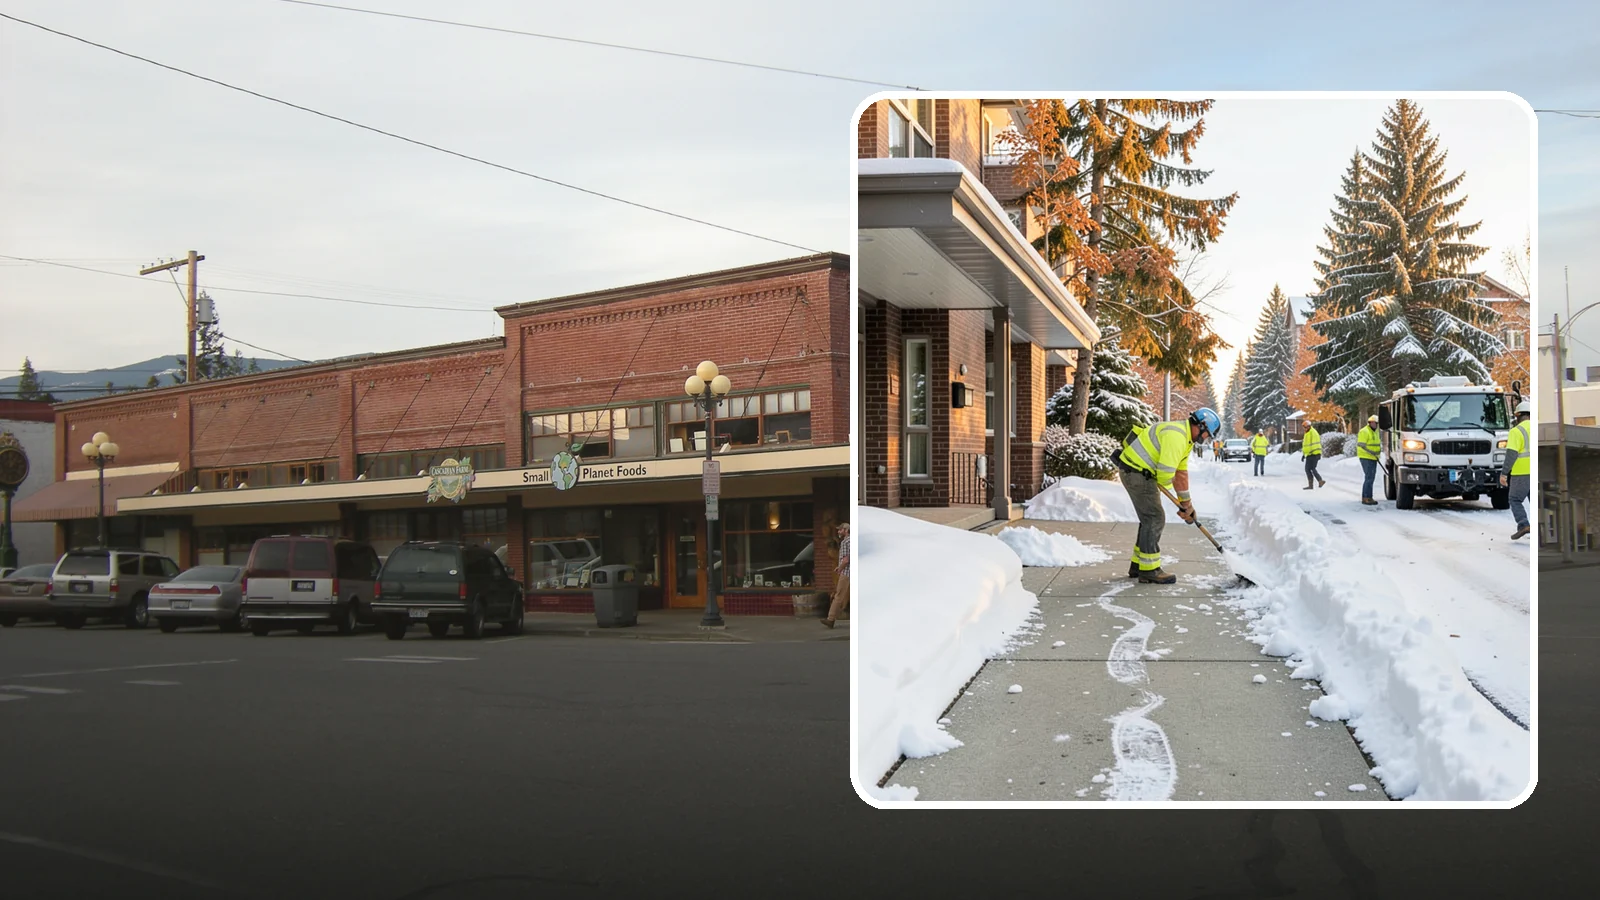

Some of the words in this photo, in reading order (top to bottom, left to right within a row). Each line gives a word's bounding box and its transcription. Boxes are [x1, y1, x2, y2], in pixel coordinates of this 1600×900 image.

[522, 471, 549, 483] Small
[582, 467, 614, 479] Planet
[616, 464, 647, 477] Foods
